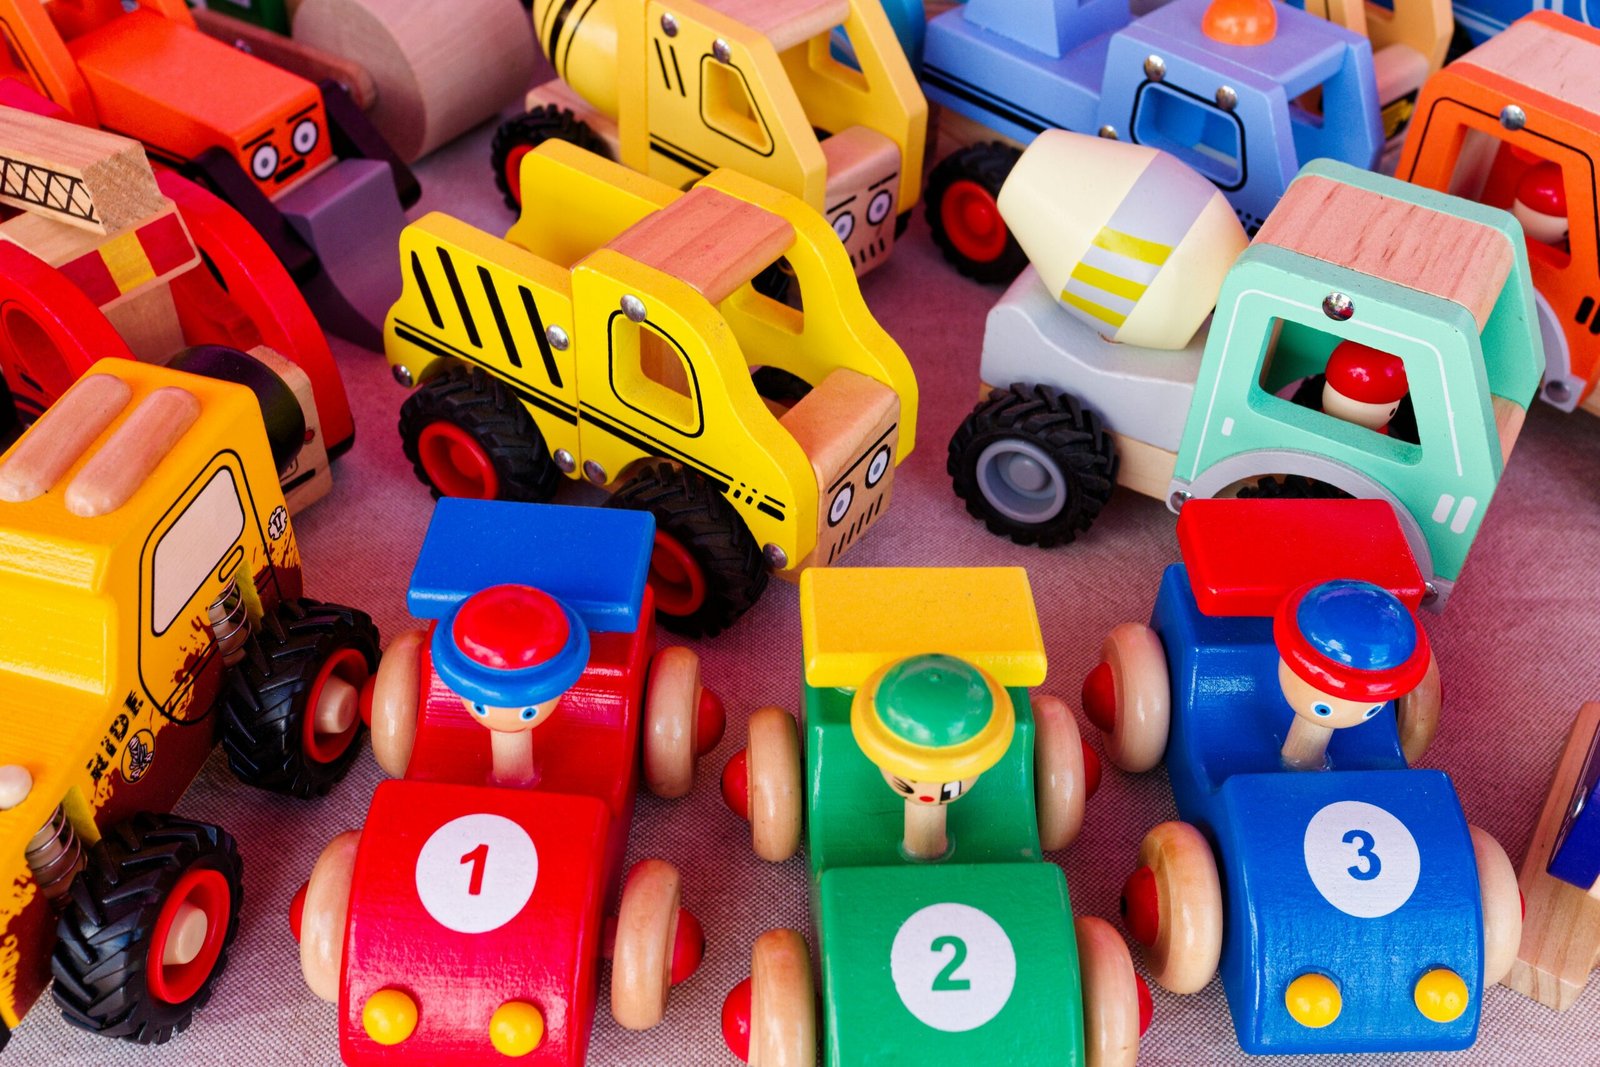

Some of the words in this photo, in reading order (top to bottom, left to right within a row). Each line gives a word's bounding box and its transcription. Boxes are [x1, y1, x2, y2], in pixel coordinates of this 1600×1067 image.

[460, 843, 489, 897] 1
[1342, 829, 1381, 881] 3
[931, 936, 971, 992] 2
